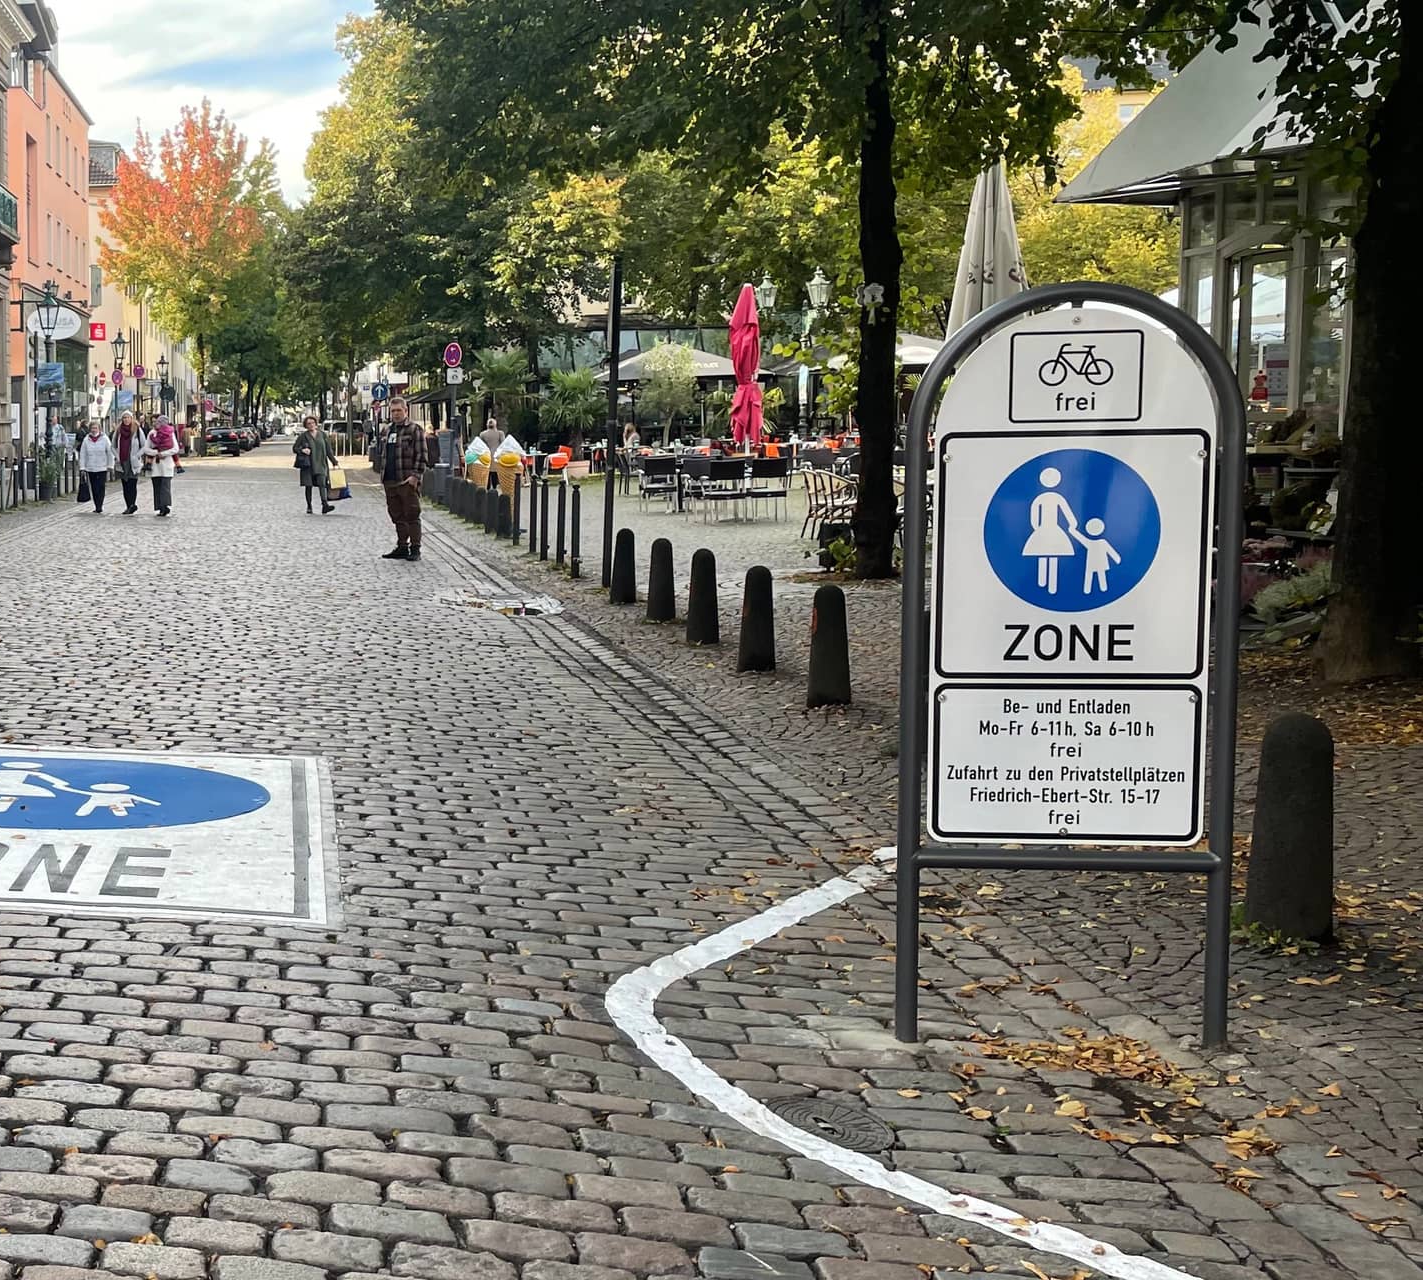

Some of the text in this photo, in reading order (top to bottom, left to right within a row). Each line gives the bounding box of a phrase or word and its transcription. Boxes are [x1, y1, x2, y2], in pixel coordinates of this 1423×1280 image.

[1056, 391, 1095, 411] frei
[1003, 624, 1135, 661] ZONE
[1003, 699, 1131, 715] Be- und Entladen
[979, 720, 1024, 736] Mo-Fr
[1084, 721, 1102, 736] Sa
[1050, 742, 1082, 758] frei
[947, 765, 1185, 786] Zufahrt zu den Privatstellplätzen
[970, 787, 1161, 804] Friedrich-Ebert-Str. 15-17
[1048, 810, 1081, 825] frei
